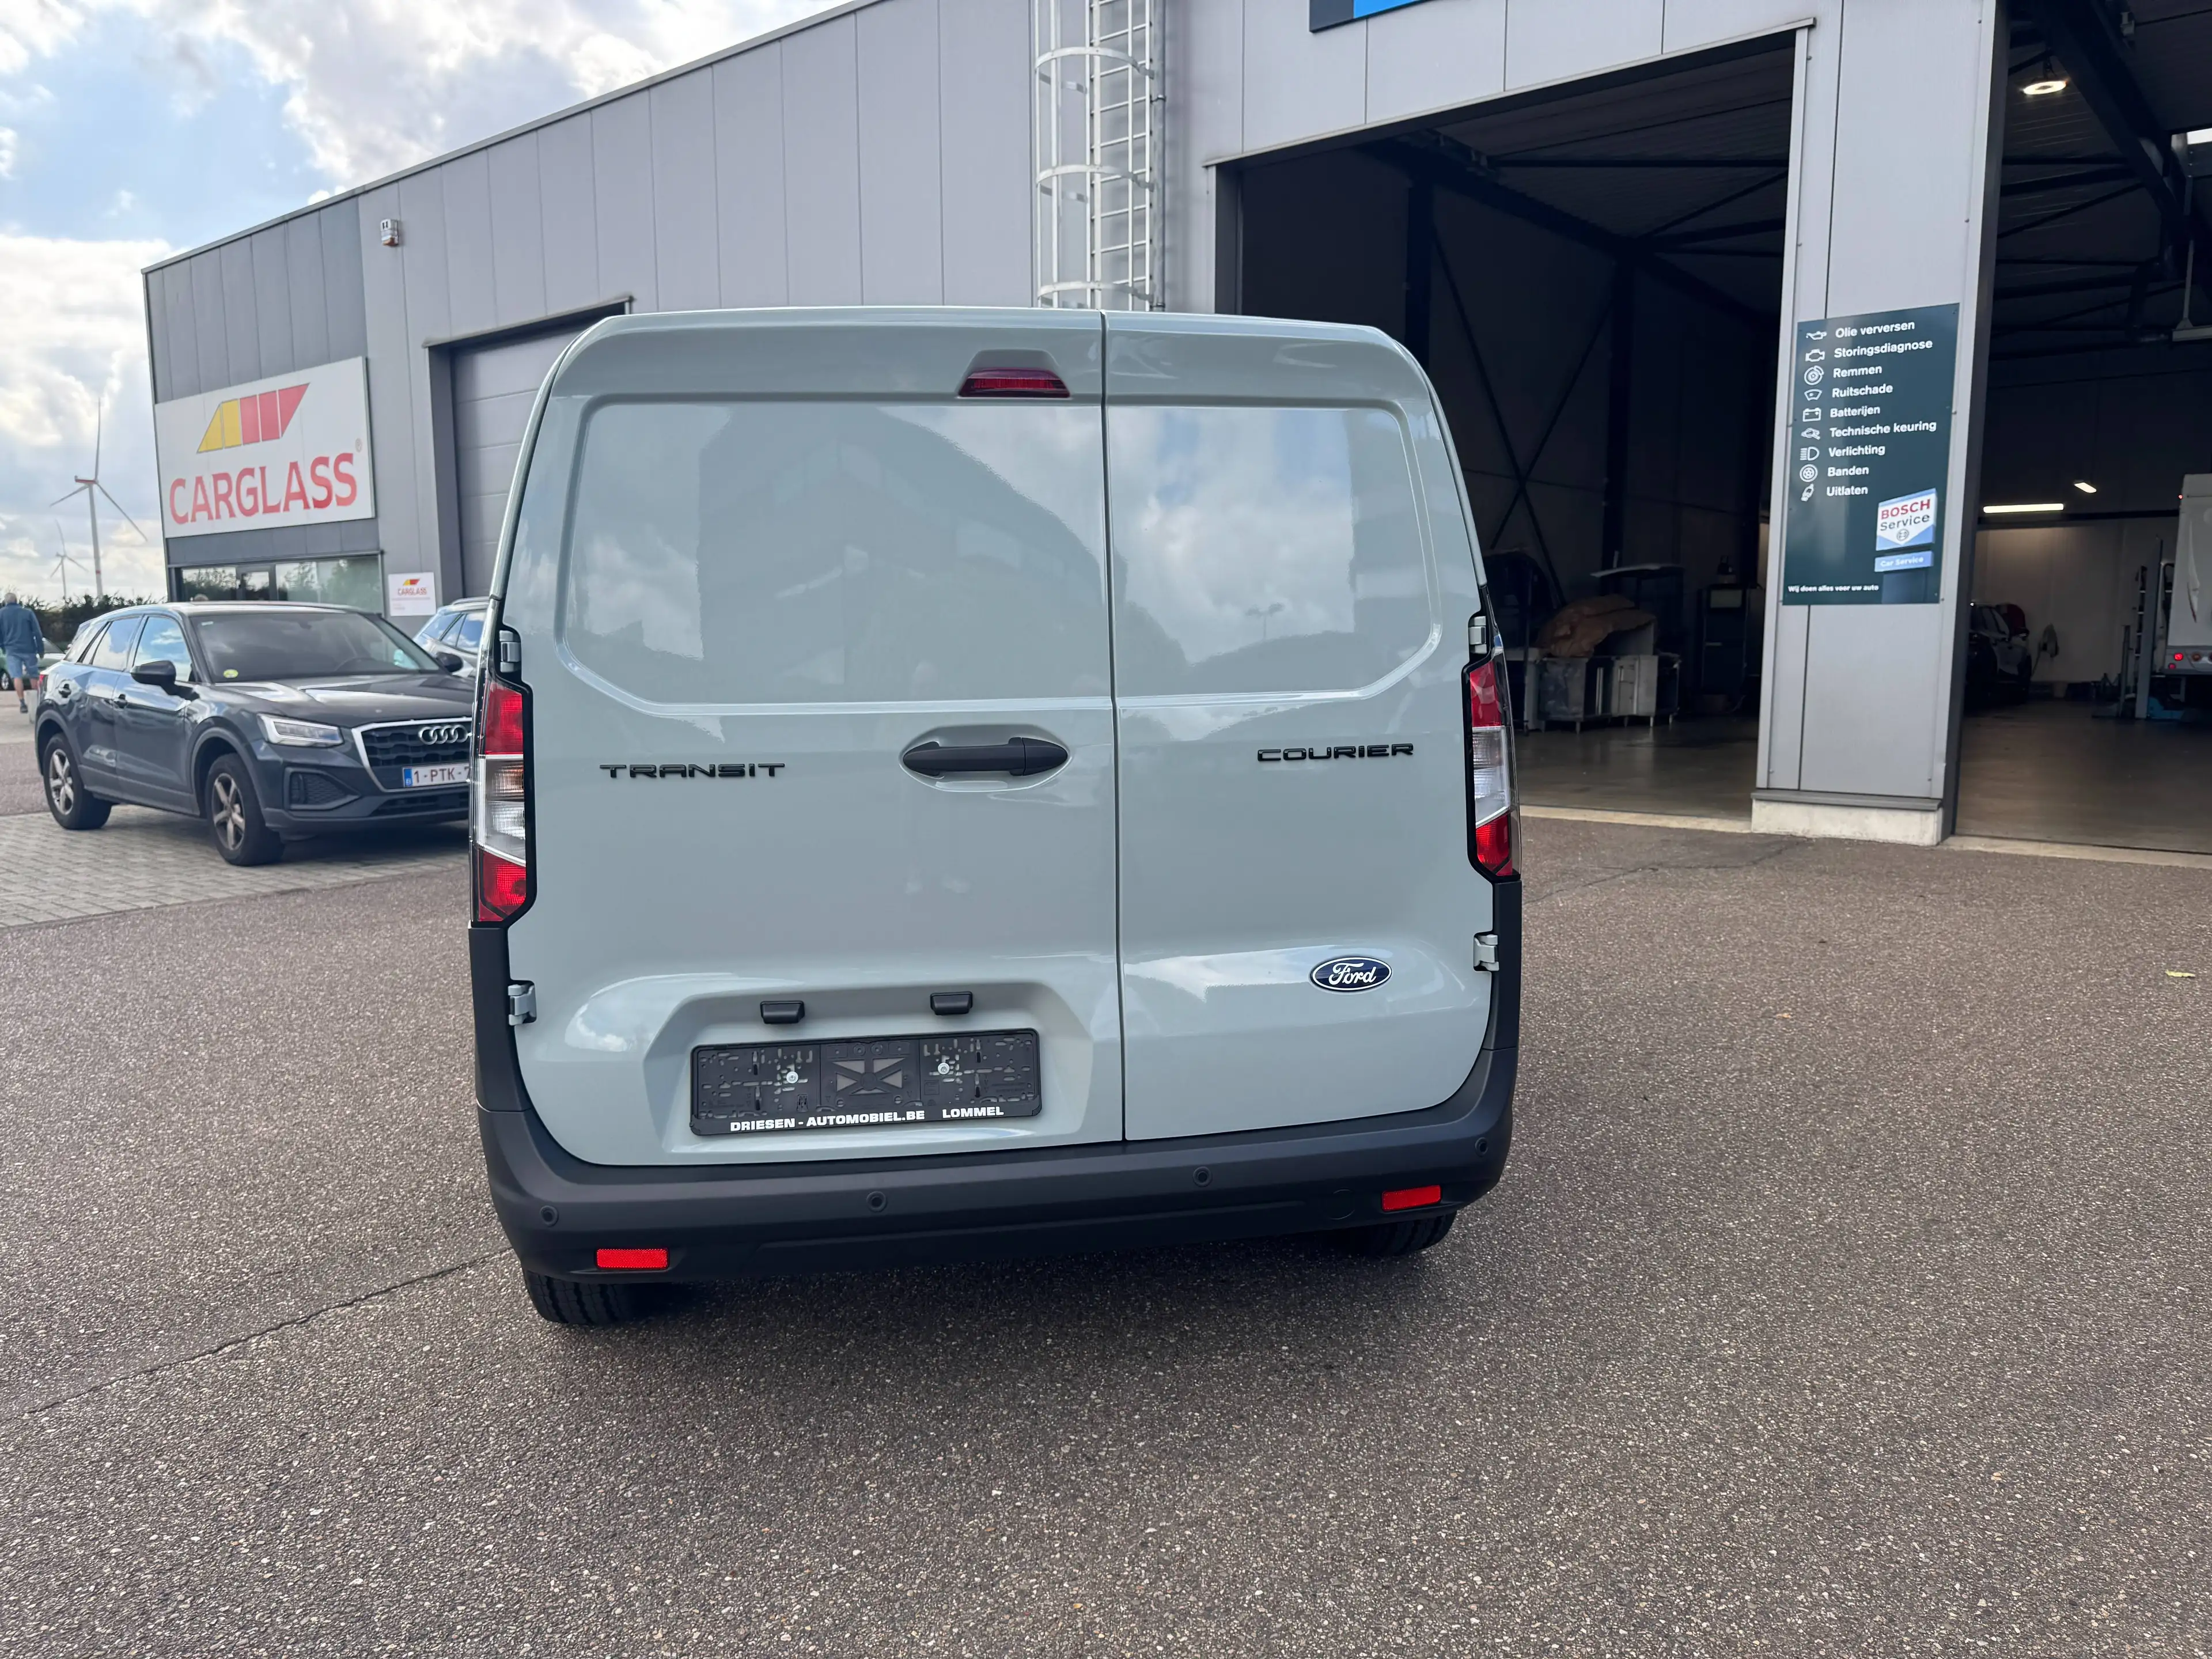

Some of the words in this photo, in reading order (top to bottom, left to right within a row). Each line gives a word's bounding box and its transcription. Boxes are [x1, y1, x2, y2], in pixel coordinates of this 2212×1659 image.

[1835, 327, 1857, 338] Olie
[1860, 321, 1915, 335] verversen
[1834, 340, 1933, 358] Storingsdiagnose
[1833, 365, 1883, 378] Remmen
[1832, 383, 1893, 398] Ruitschade
[1830, 405, 1881, 418] Batterijen
[1830, 423, 1891, 438] Technische
[1893, 421, 1937, 433] keuring
[1828, 445, 1885, 458] Verlichting
[1827, 466, 1869, 477] Banden
[169, 453, 357, 525] CARGLASS
[1826, 485, 1868, 497] Uitlaten
[1881, 498, 1931, 520] BOSCH
[1880, 514, 1930, 531] Service
[1895, 556, 1925, 566] Service
[397, 587, 427, 596] CARGLASS
[1257, 743, 1414, 762] COURIER
[599, 763, 785, 778] TRANSIT
[1328, 963, 1377, 985] Ford
[730, 1118, 796, 1132] DRIESEN
[806, 1110, 926, 1127] AUTOMOBIEL.BE
[942, 1106, 1005, 1119] LOMMEL
